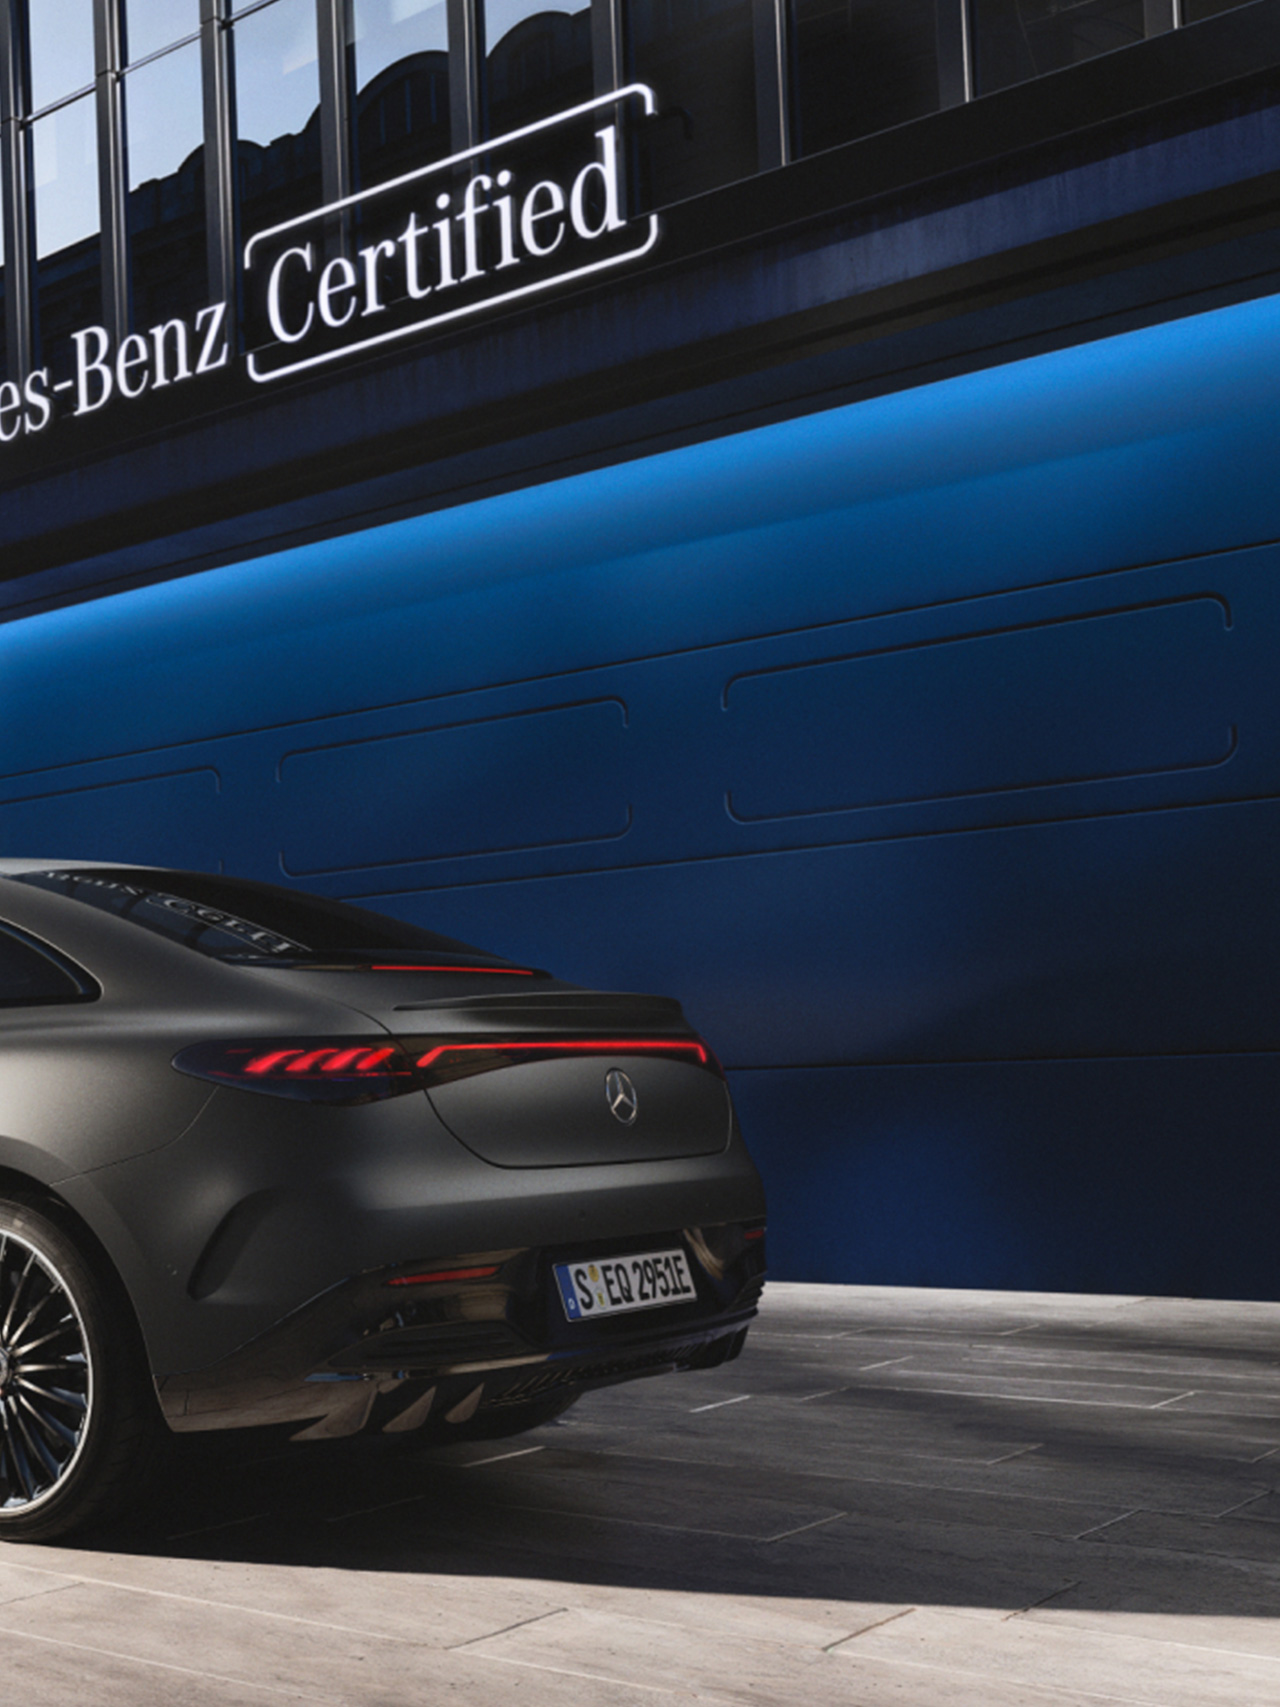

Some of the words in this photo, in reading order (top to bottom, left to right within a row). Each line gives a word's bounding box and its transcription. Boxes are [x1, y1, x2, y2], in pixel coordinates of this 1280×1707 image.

[267, 126, 627, 344] Certified
[574, 1268, 594, 1310] S
[601, 1263, 634, 1306] EQ
[631, 1255, 692, 1301] 2951E
